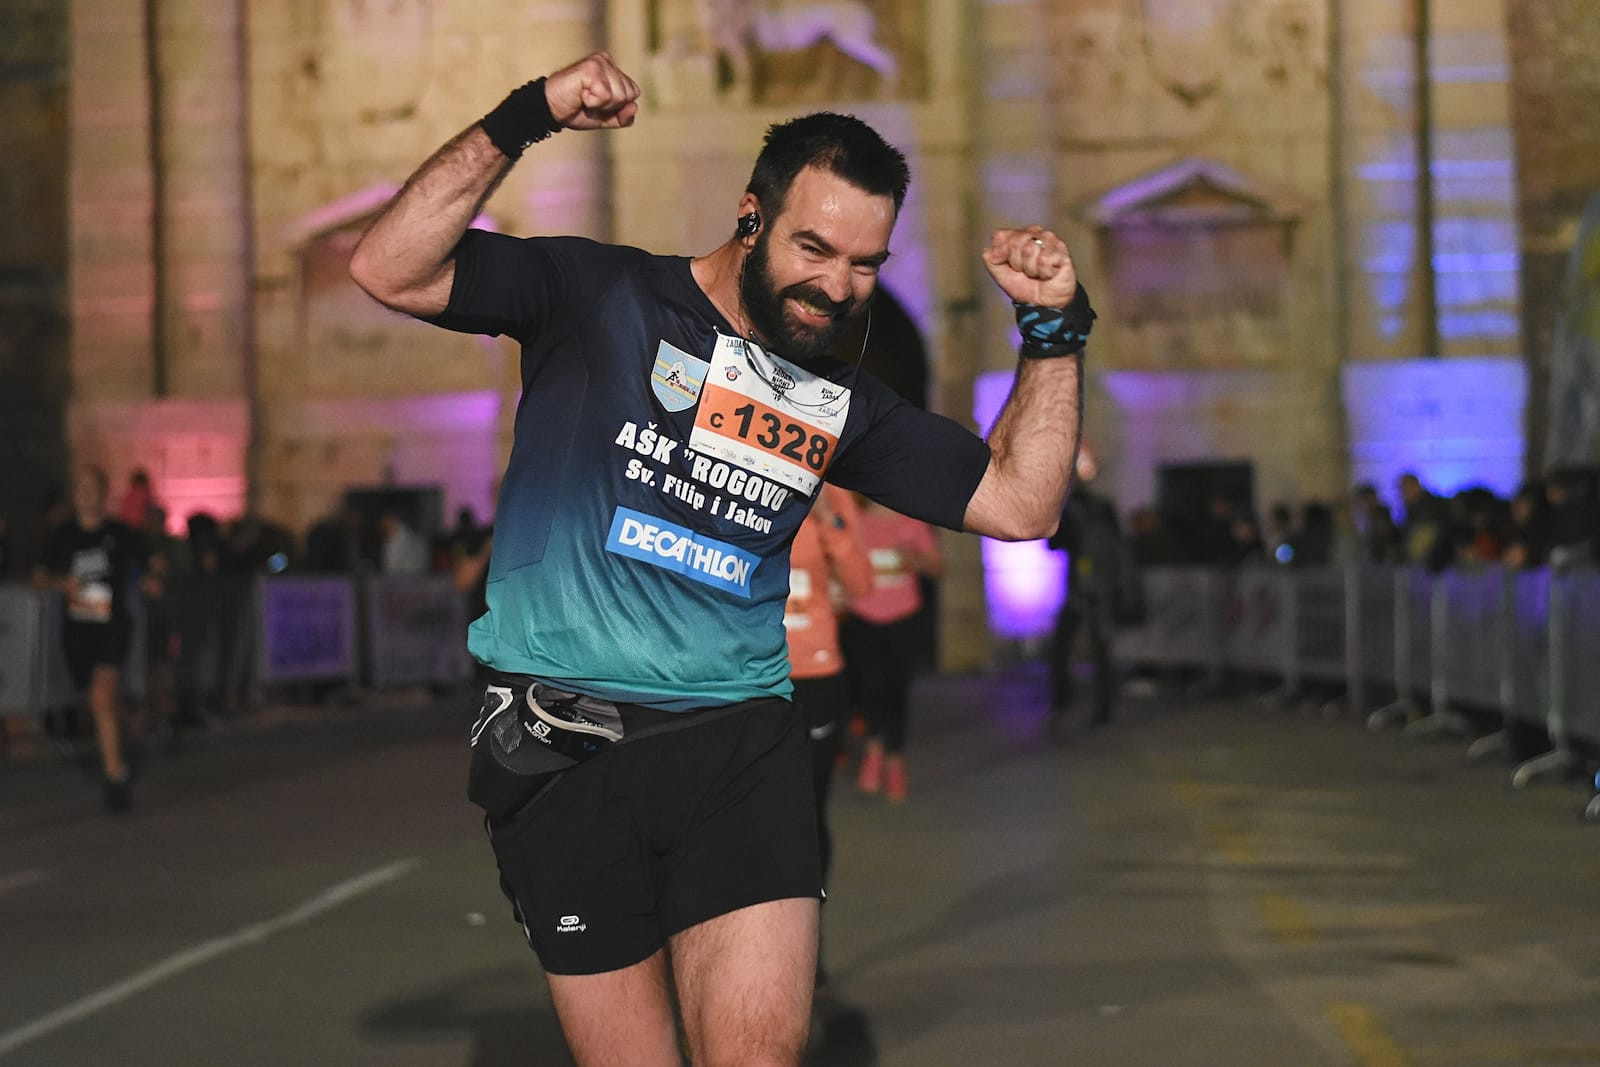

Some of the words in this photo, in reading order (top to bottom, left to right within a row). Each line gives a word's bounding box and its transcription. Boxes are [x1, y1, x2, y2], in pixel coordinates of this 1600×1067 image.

[615, 421, 678, 465] AŠK
[734, 403, 829, 470] 1328
[625, 458, 656, 487] Sv.
[662, 474, 705, 511] Filip
[710, 496, 722, 515] i
[724, 501, 773, 535] Jakov
[618, 518, 750, 587] DECATHLON
